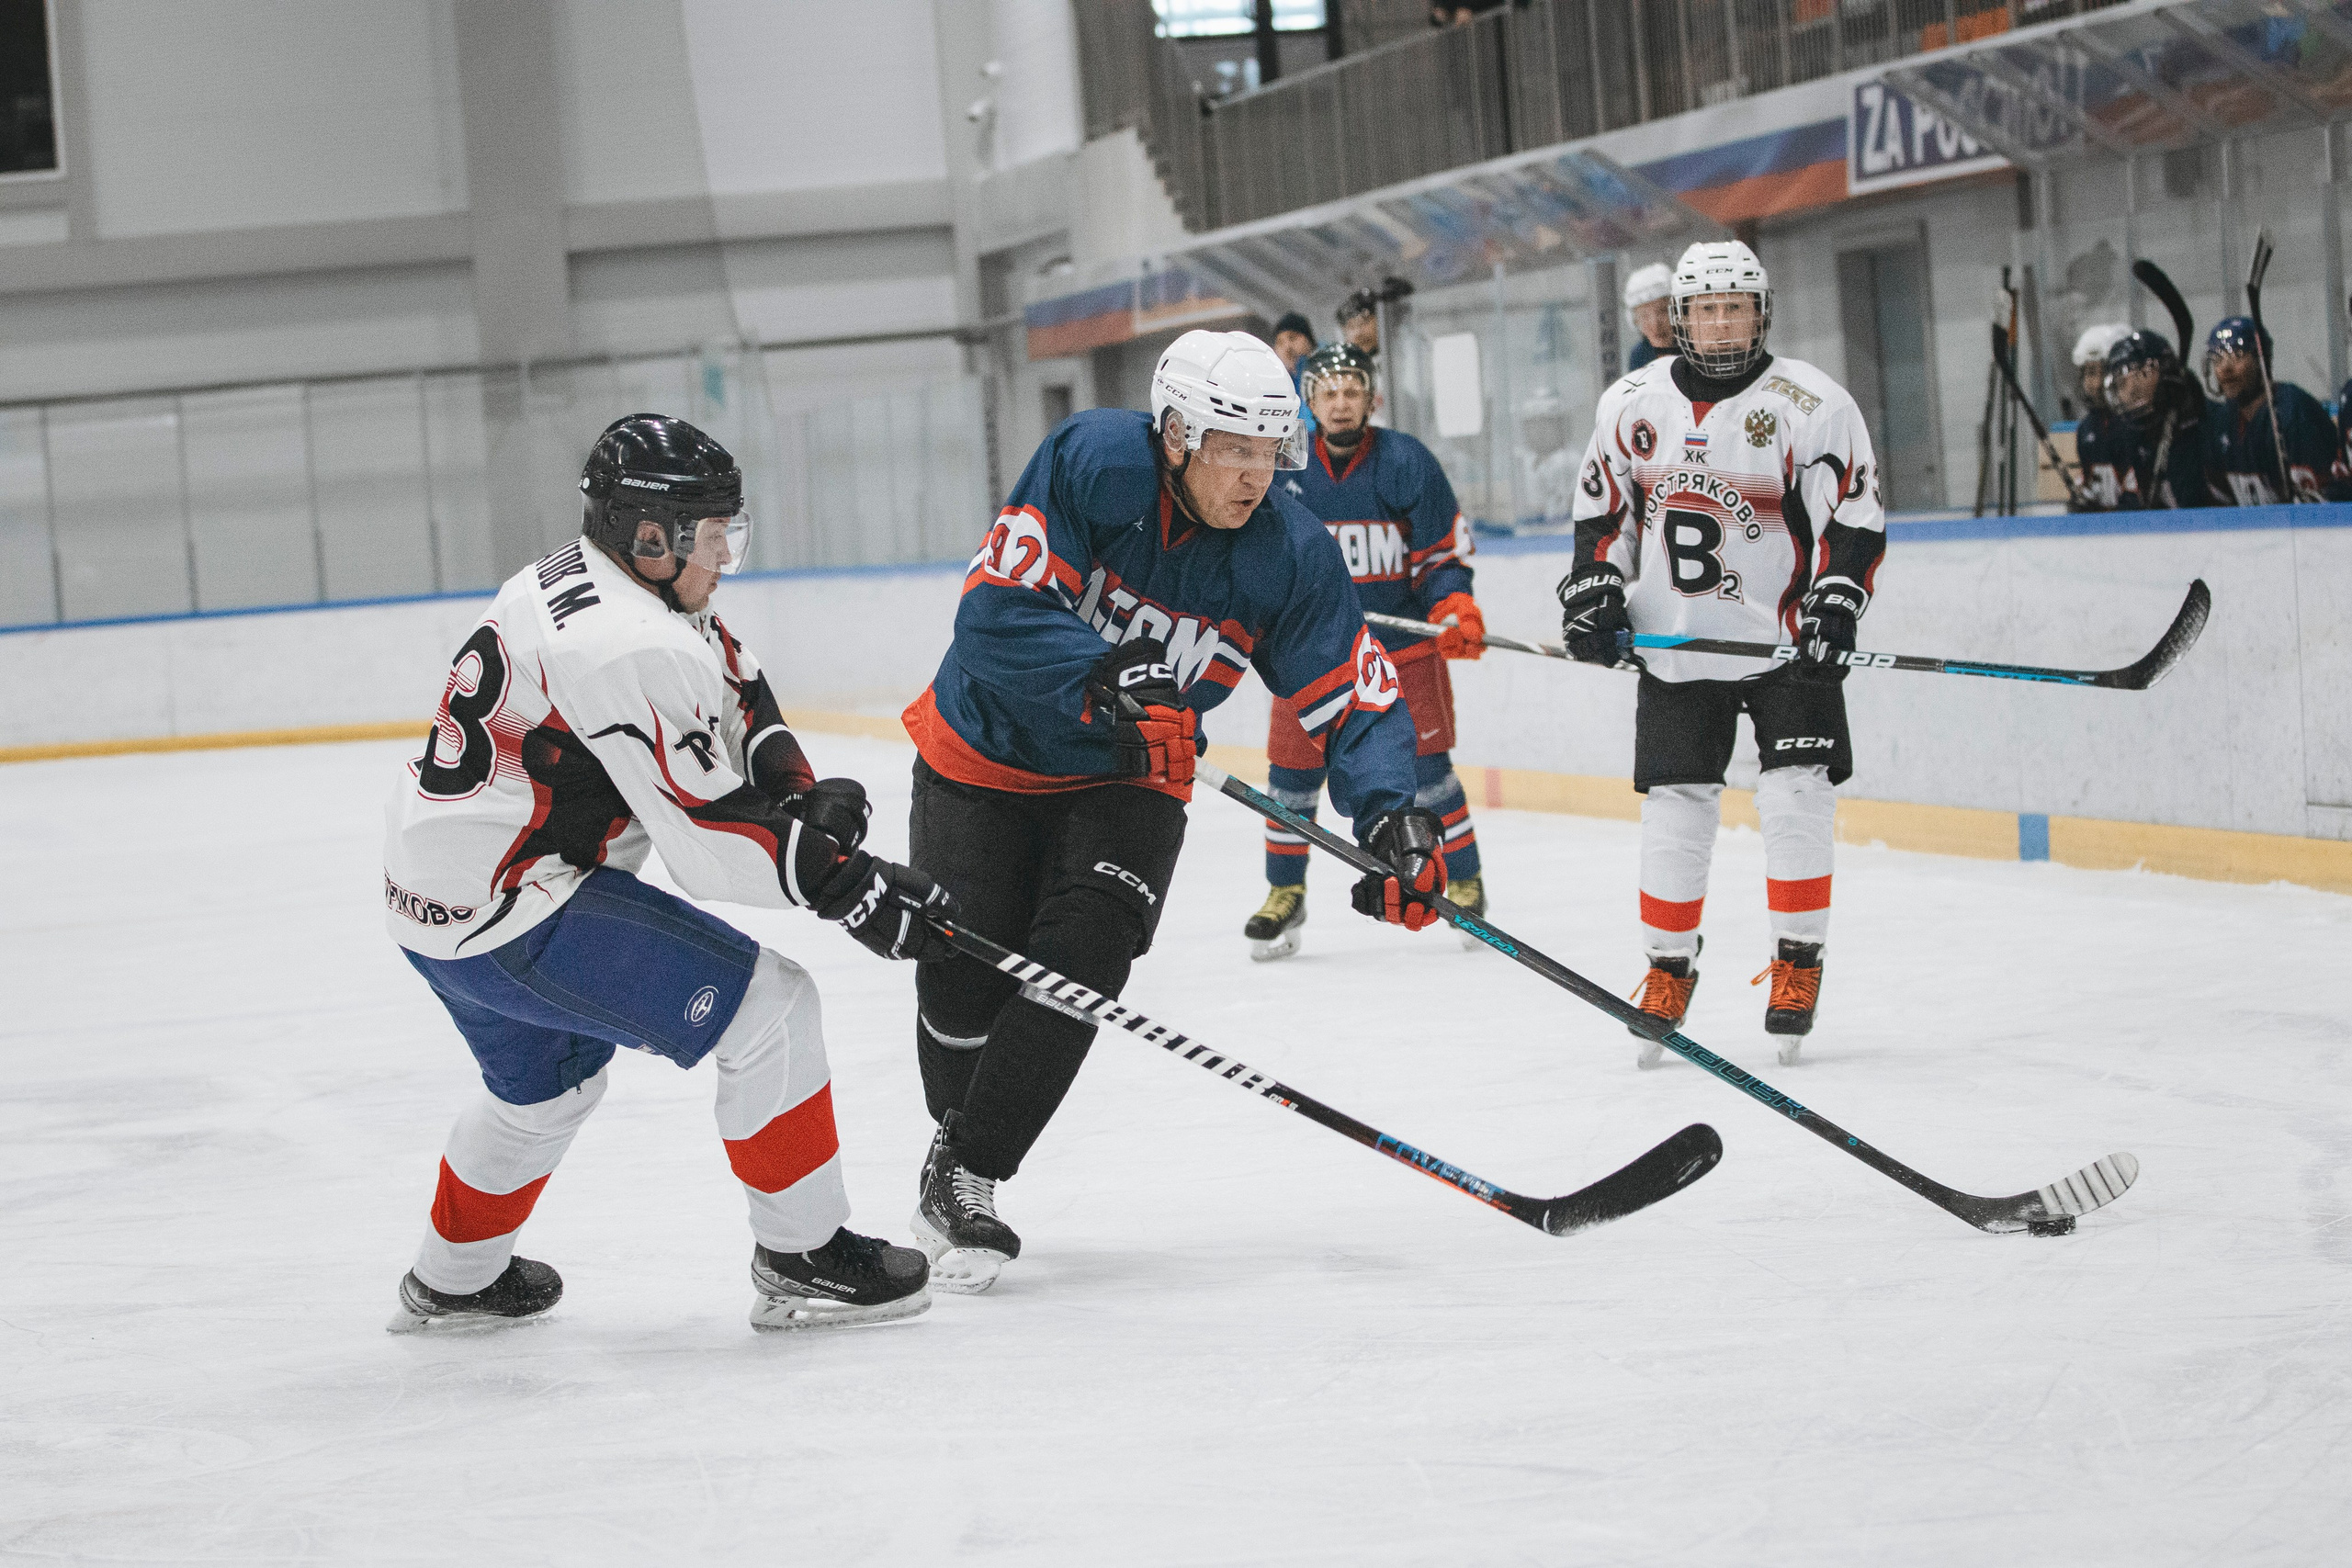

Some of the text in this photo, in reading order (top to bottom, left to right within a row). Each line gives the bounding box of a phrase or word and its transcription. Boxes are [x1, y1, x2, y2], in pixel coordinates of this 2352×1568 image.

[1165, 384, 1188, 401] CCM
[1259, 408, 1293, 418] CCM
[1683, 449, 1707, 464] ХК
[621, 477, 671, 491] BAUER
[1564, 574, 1623, 602] BAUE
[1774, 737, 1835, 751] CCM
[1093, 861, 1157, 906] CCM
[1036, 994, 1084, 1021] BAUER
[1661, 1030, 1810, 1119] BAUER
[811, 1277, 856, 1294] BAUER
